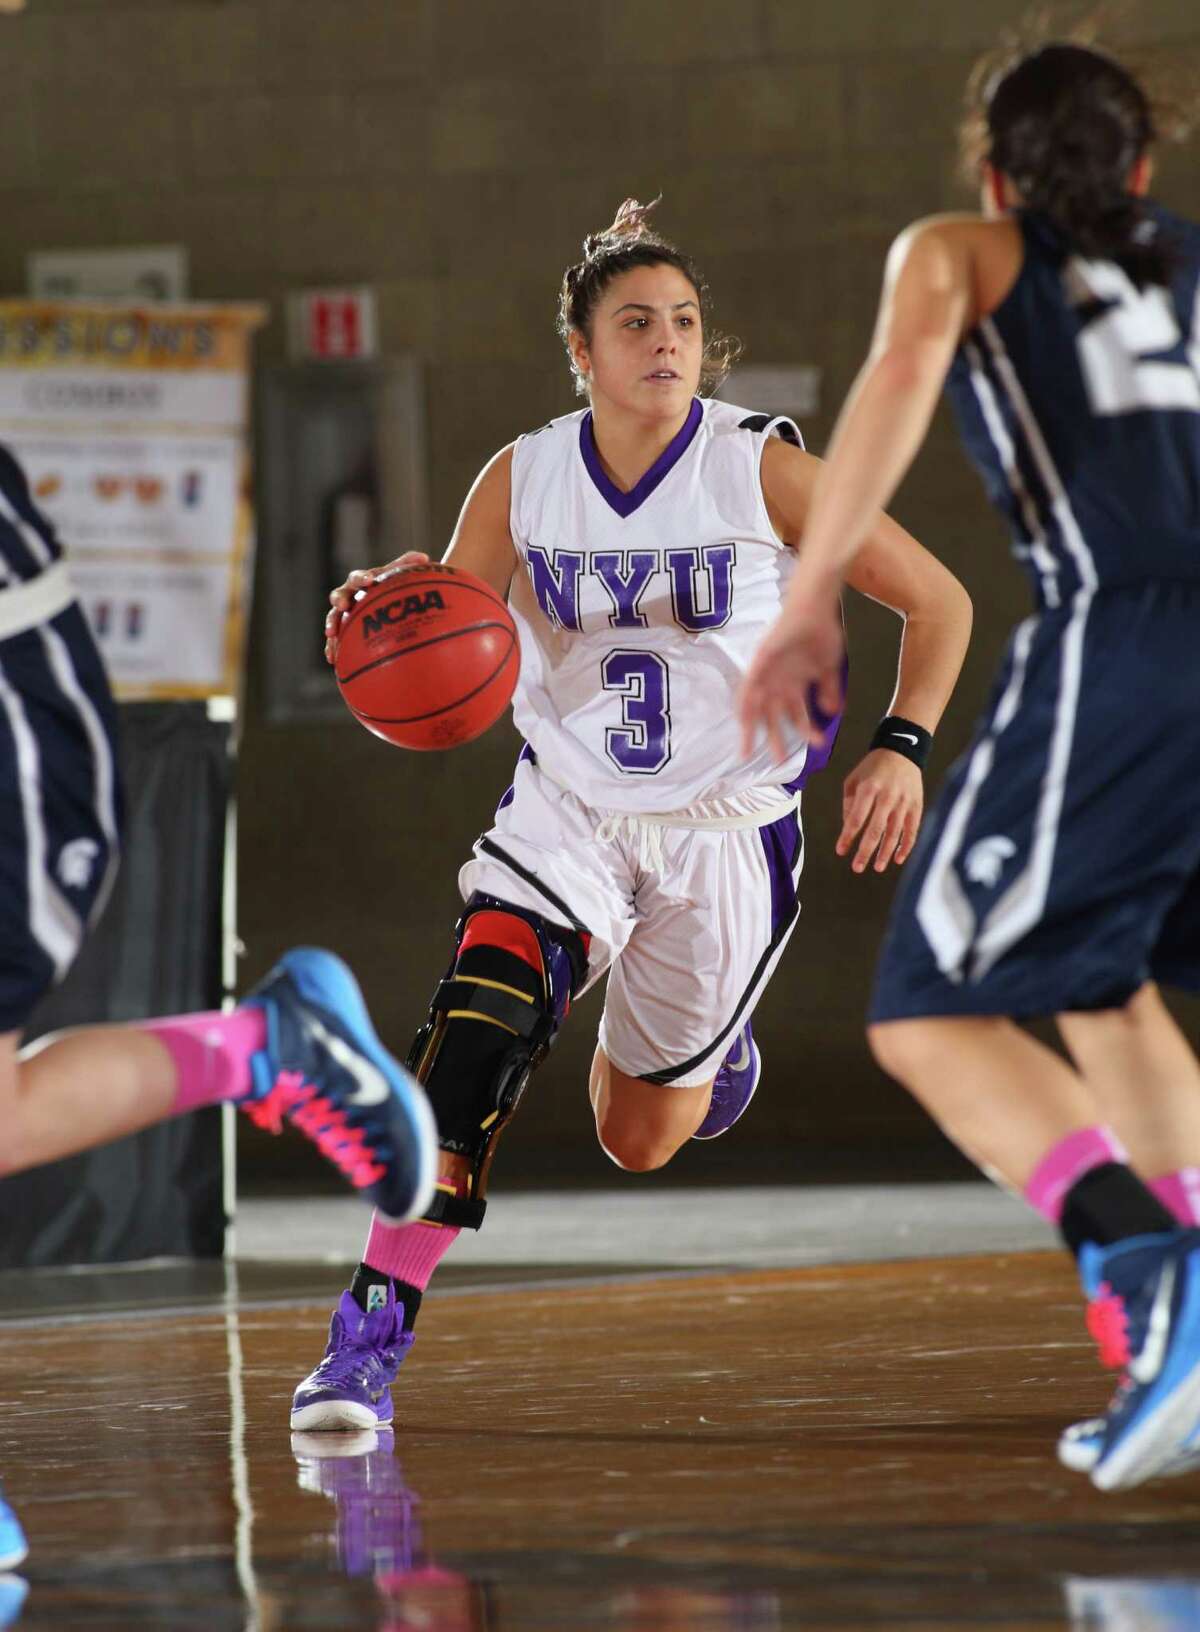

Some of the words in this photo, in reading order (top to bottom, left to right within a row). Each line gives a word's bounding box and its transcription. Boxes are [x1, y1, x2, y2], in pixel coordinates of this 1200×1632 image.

[1065, 256, 1200, 416] 2
[362, 590, 445, 639] NCAA
[526, 543, 737, 633] NYU
[600, 648, 672, 775] 3
